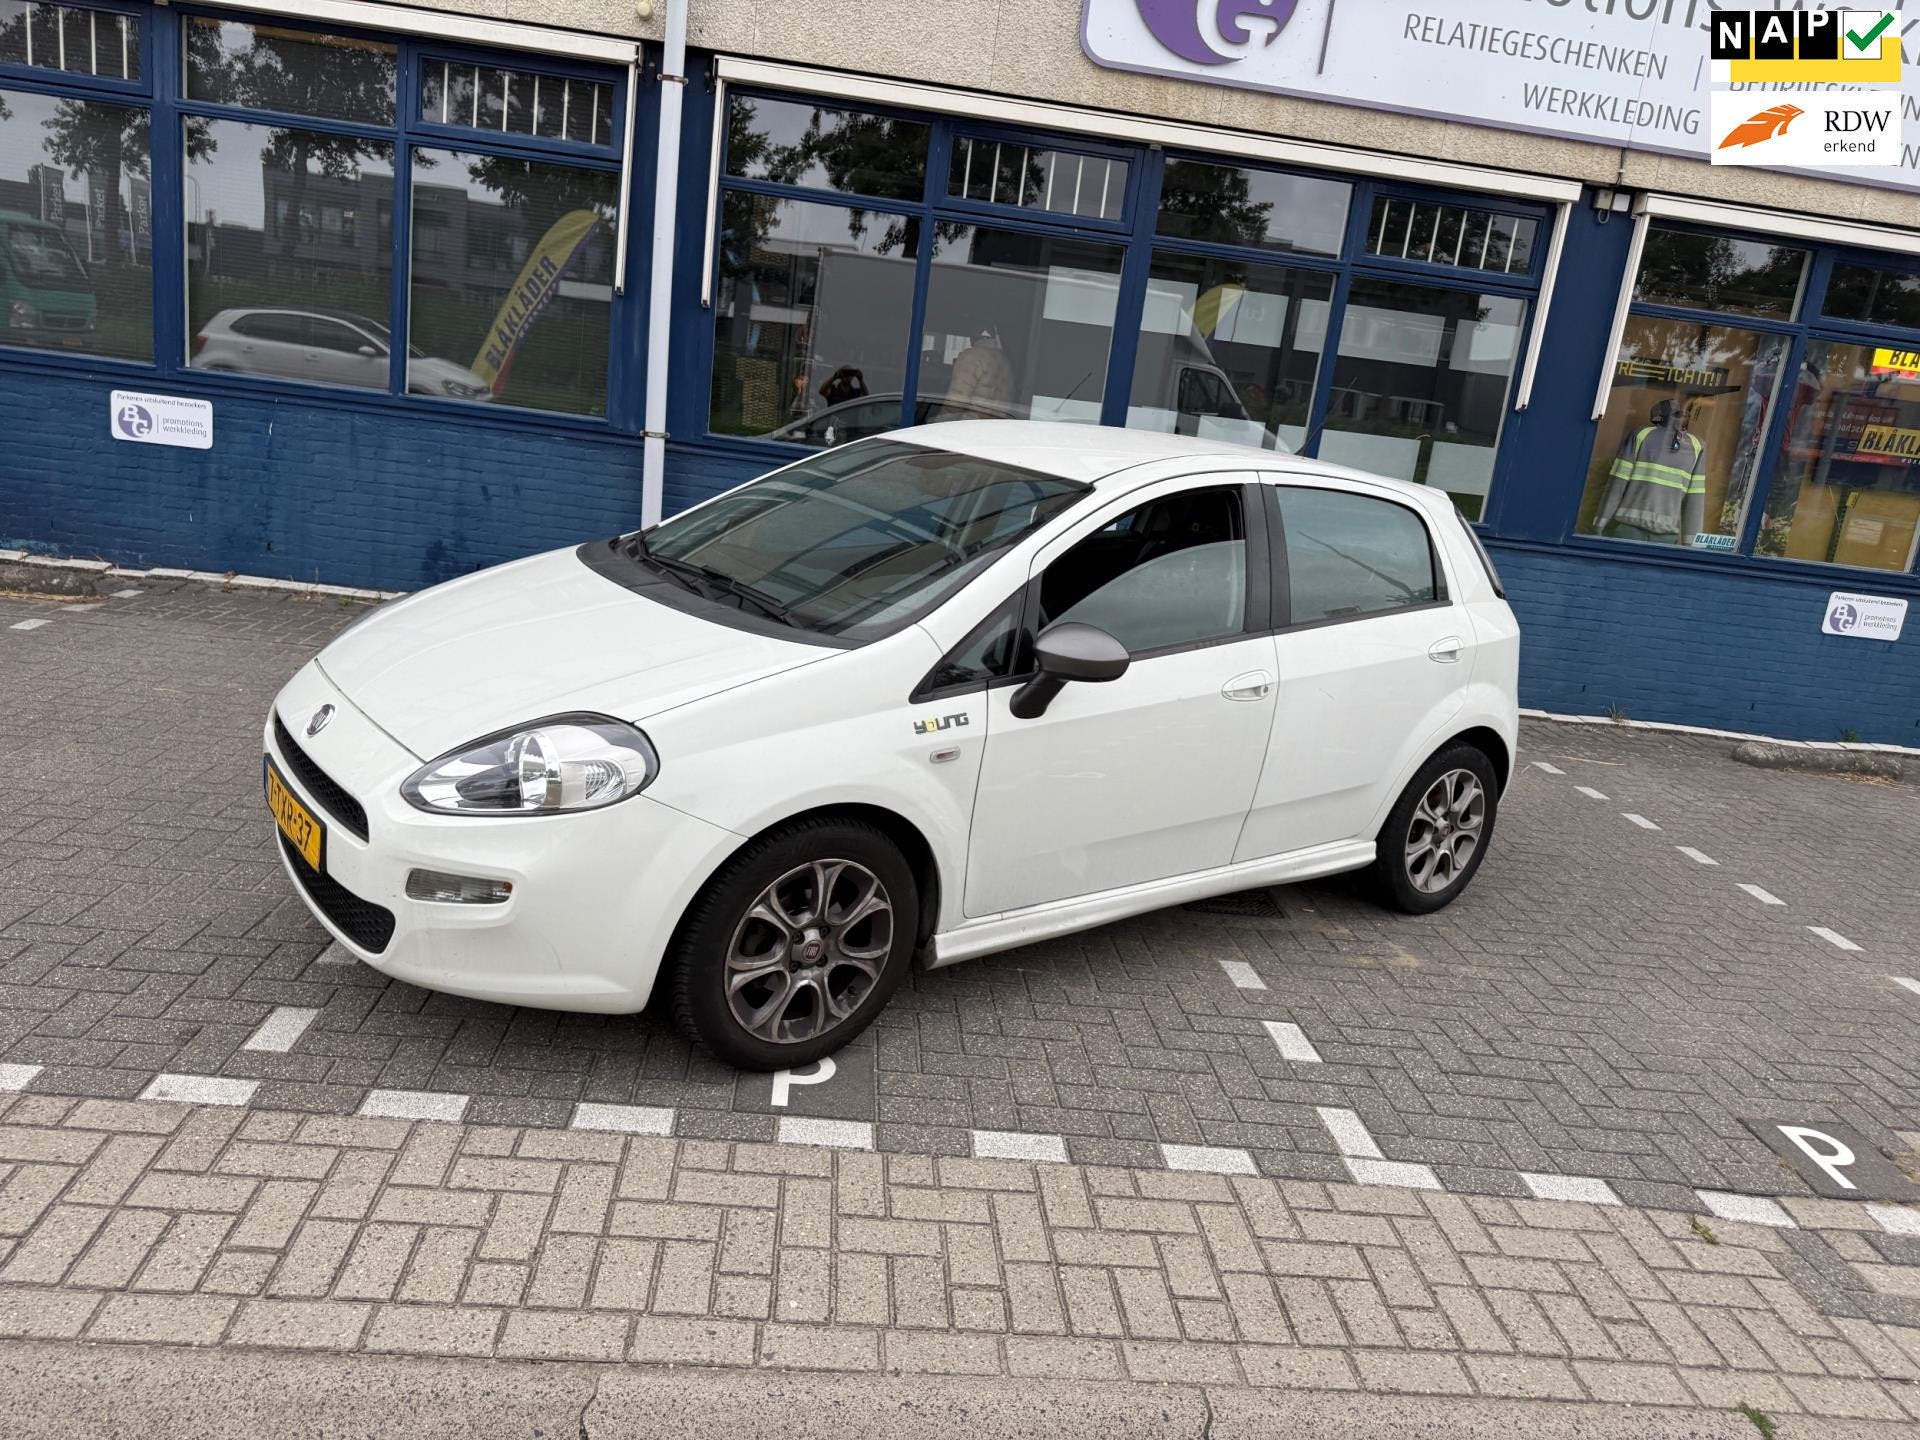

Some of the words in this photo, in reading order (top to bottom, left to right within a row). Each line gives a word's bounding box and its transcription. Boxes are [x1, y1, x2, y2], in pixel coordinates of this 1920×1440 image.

[1403, 13, 1668, 80] RELATIEGESCHENKEN
[1523, 82, 1701, 135] WERKKLEDING
[162, 417, 204, 428] promotions
[162, 425, 207, 438] werkkleding
[268, 774, 312, 852] 7-TXR-37
[1776, 1125, 1858, 1189] P
